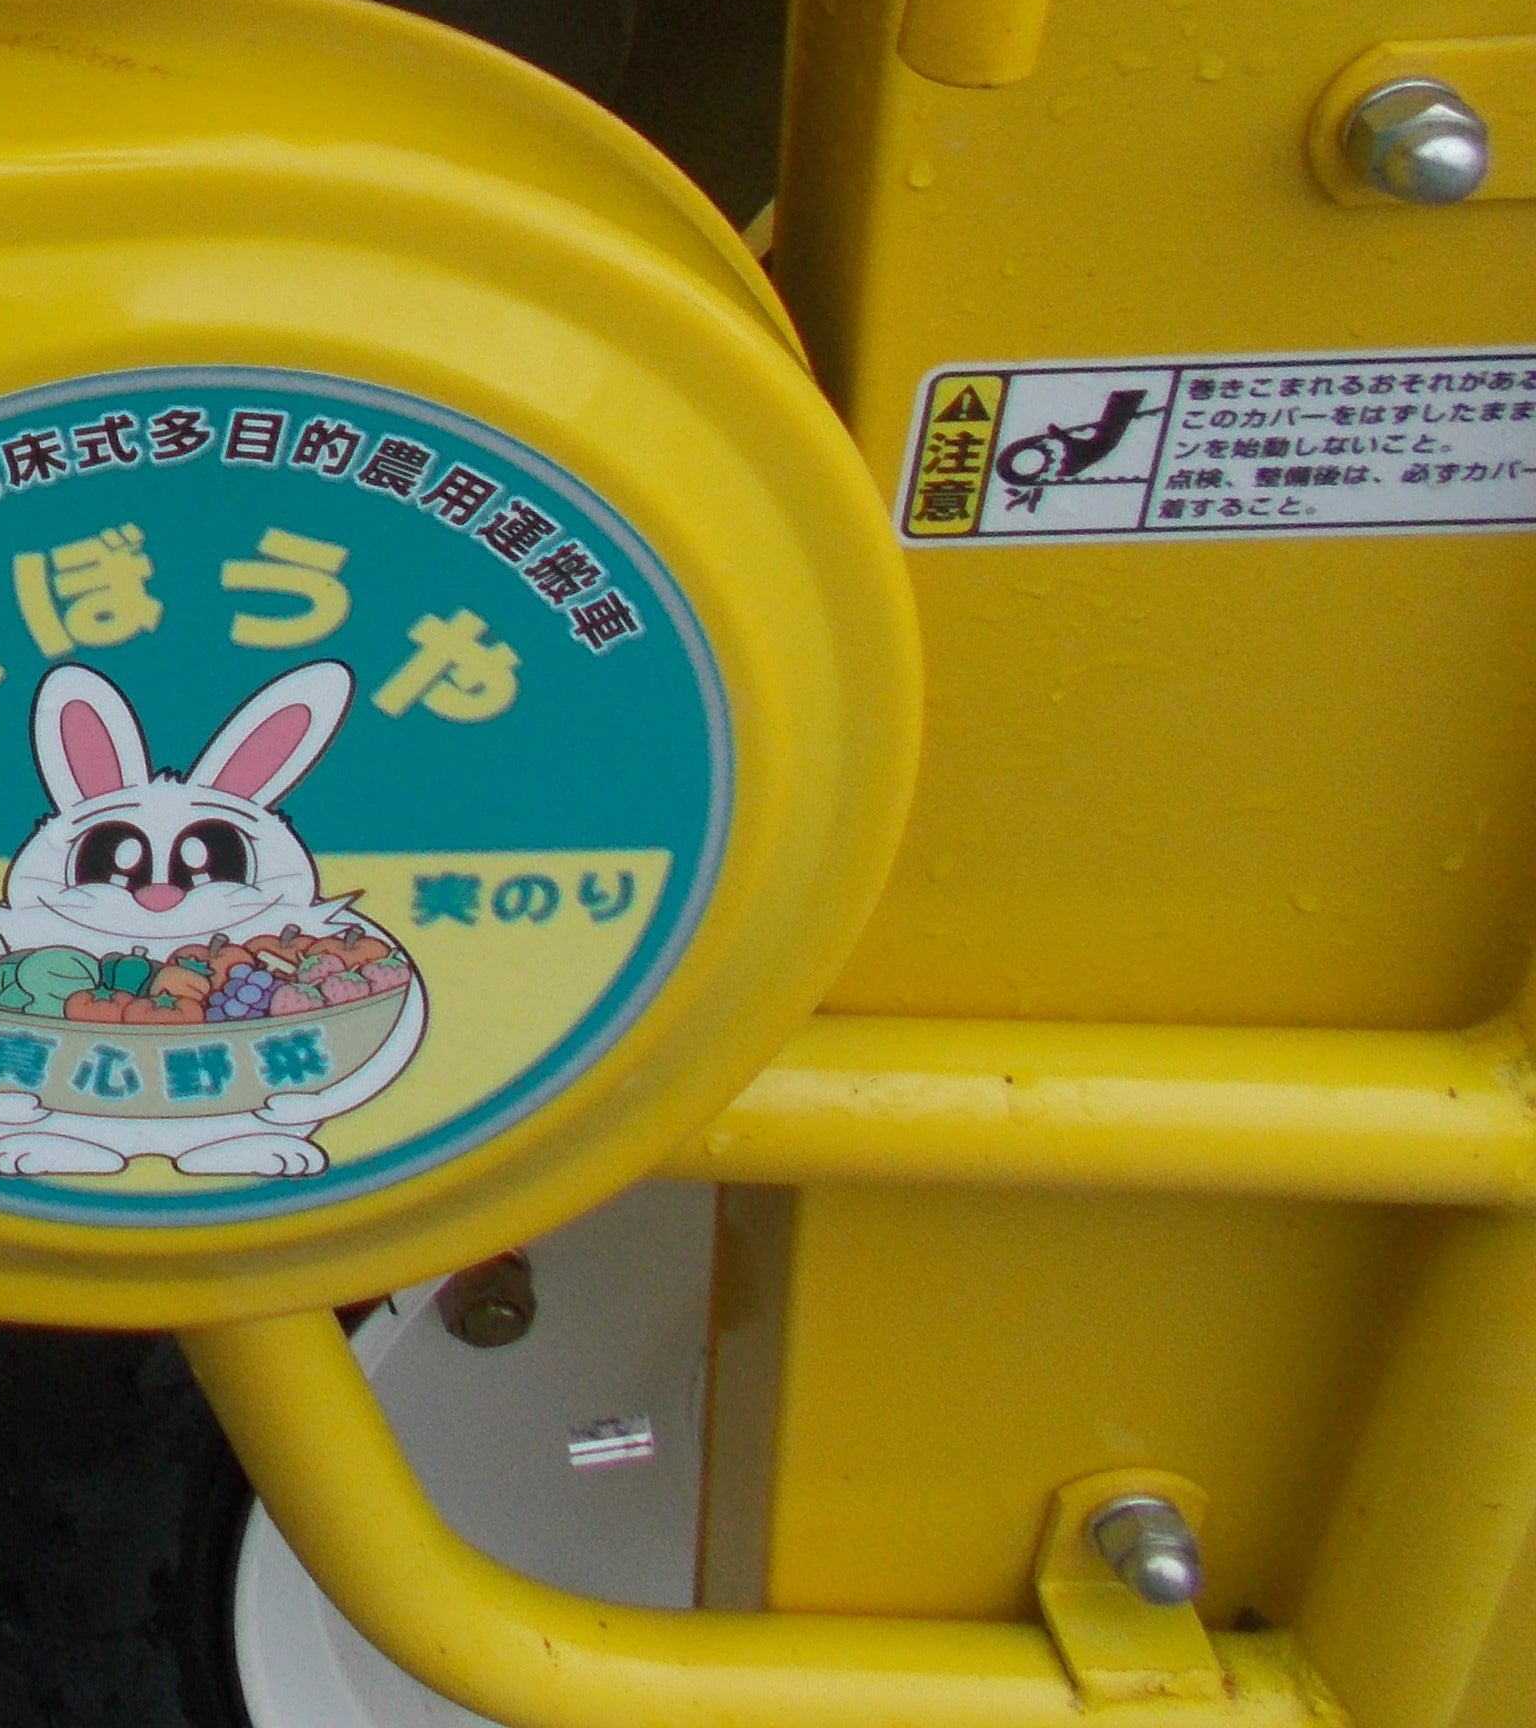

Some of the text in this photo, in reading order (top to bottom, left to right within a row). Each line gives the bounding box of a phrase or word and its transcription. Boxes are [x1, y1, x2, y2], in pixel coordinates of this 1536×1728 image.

[914, 430, 986, 522] 注意
[411, 868, 635, 926] 実のり
